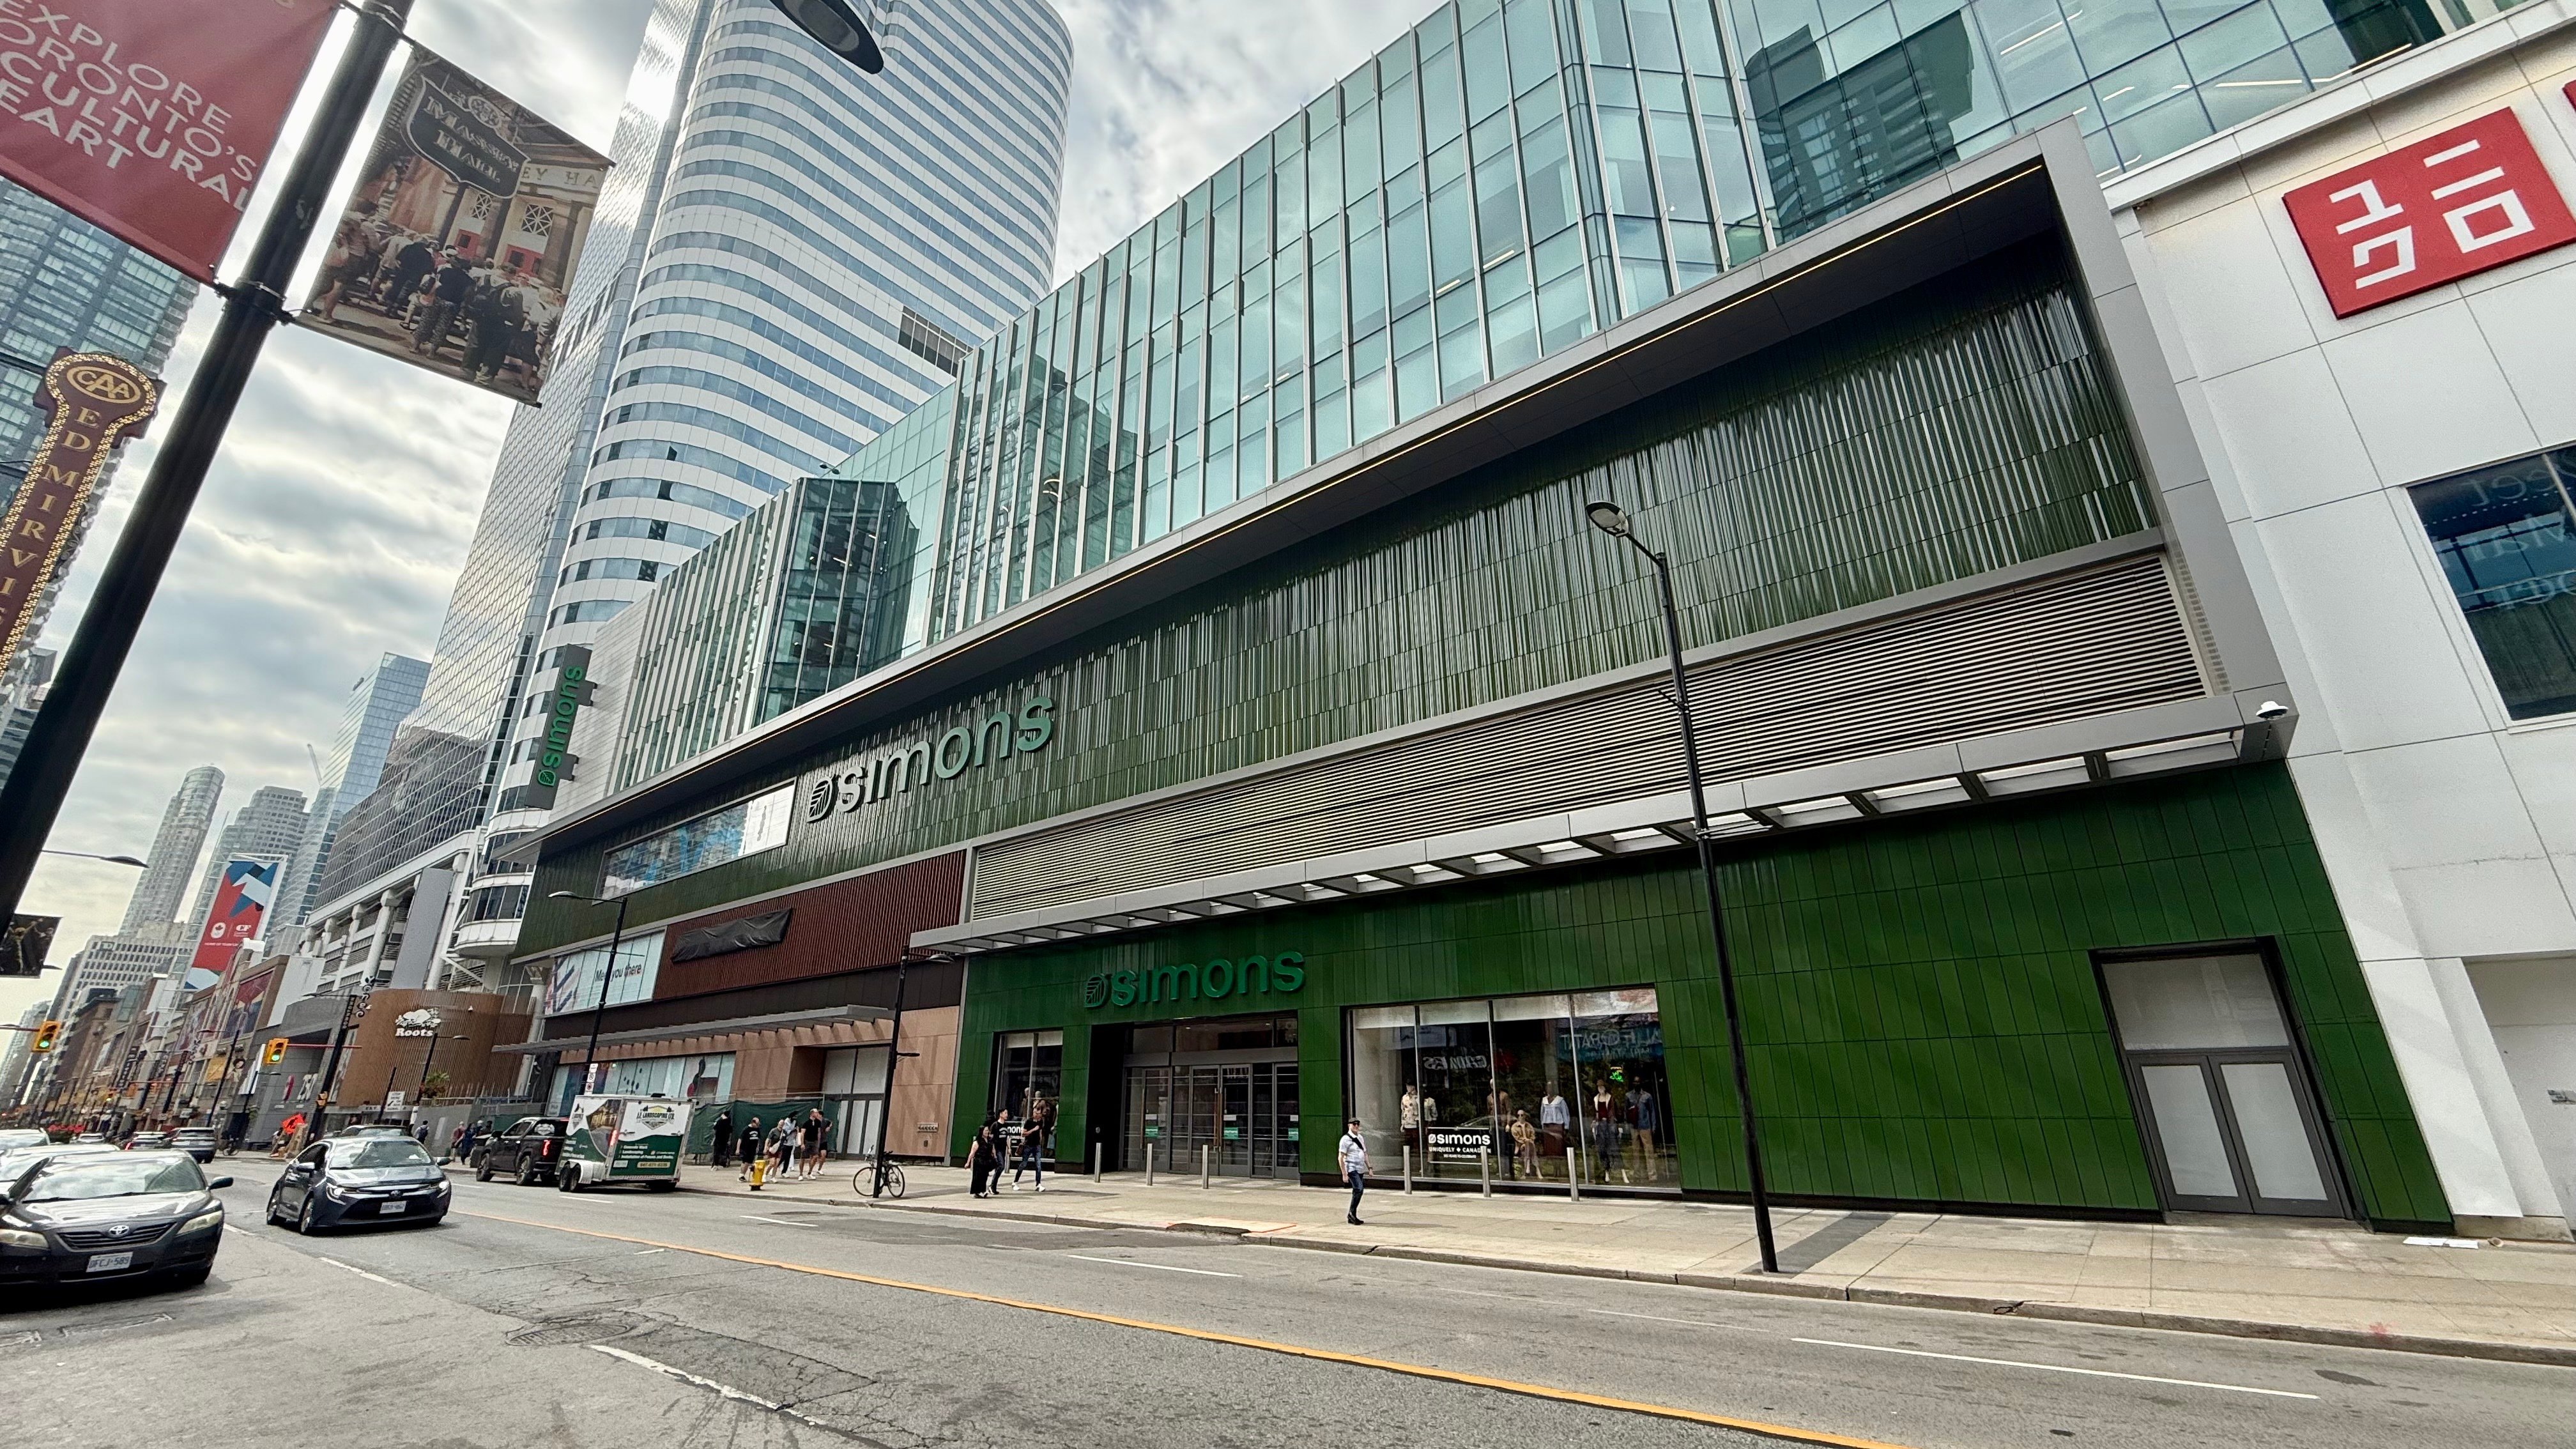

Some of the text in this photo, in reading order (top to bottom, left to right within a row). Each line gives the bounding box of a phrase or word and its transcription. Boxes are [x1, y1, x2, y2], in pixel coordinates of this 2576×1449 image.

[0, 0, 232, 134] EXPLORE
[0, 18, 256, 181] ORONTO'S
[0, 78, 134, 169] EART
[1, 51, 252, 213] CULTURAL
[76, 369, 132, 399] CAA
[61, 406, 102, 452] ED
[542, 665, 583, 769] simons
[836, 696, 1055, 813] simons
[610, 967, 624, 983] you
[624, 963, 642, 978] there
[1111, 951, 1307, 1007] simons
[395, 1027, 434, 1038] Roots
[1437, 1133, 1491, 1145] simons
